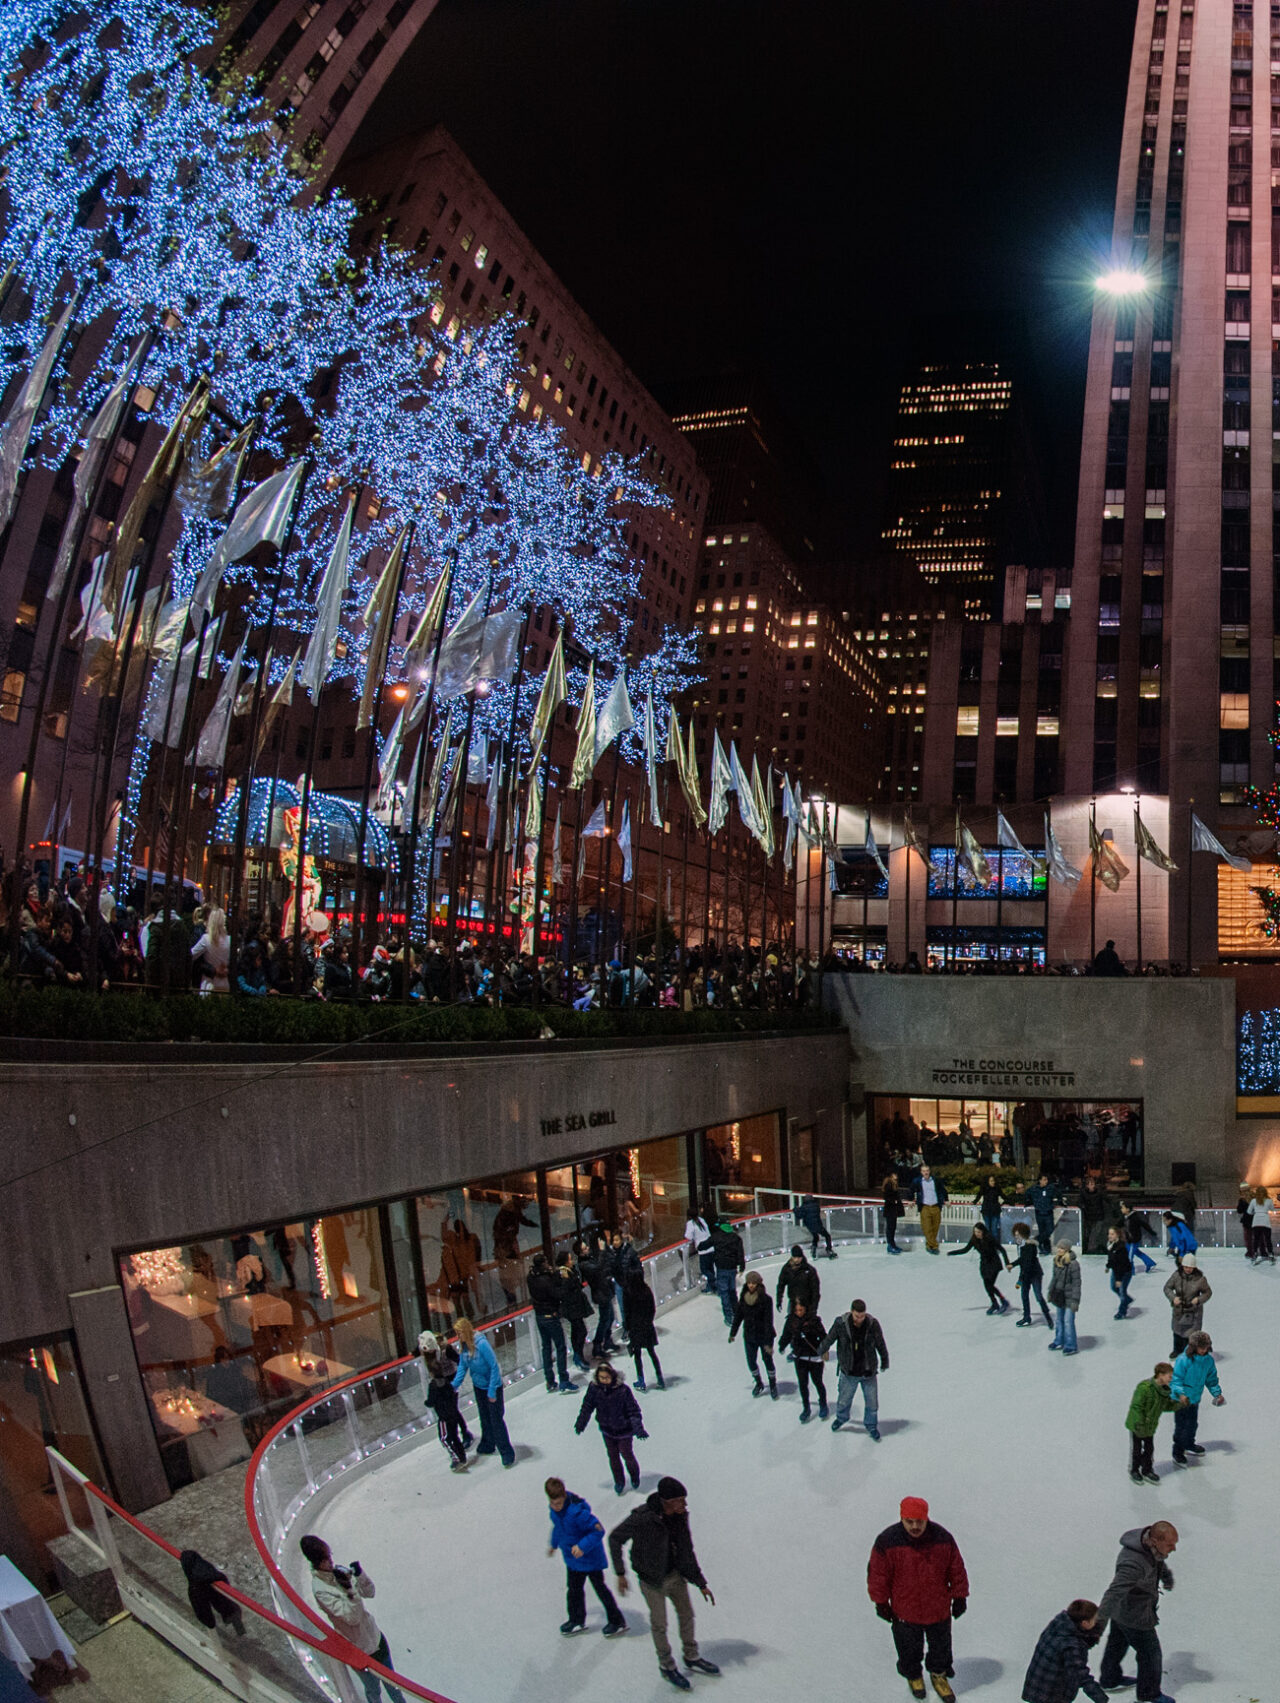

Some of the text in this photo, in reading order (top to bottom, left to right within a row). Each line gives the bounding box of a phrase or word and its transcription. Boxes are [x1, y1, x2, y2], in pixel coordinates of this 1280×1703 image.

[953, 1059, 1054, 1071] THE CONCOURSE
[932, 1074, 1075, 1087] ROCKEFELLER CENTER
[540, 1109, 617, 1136] THE SEA GRILL
